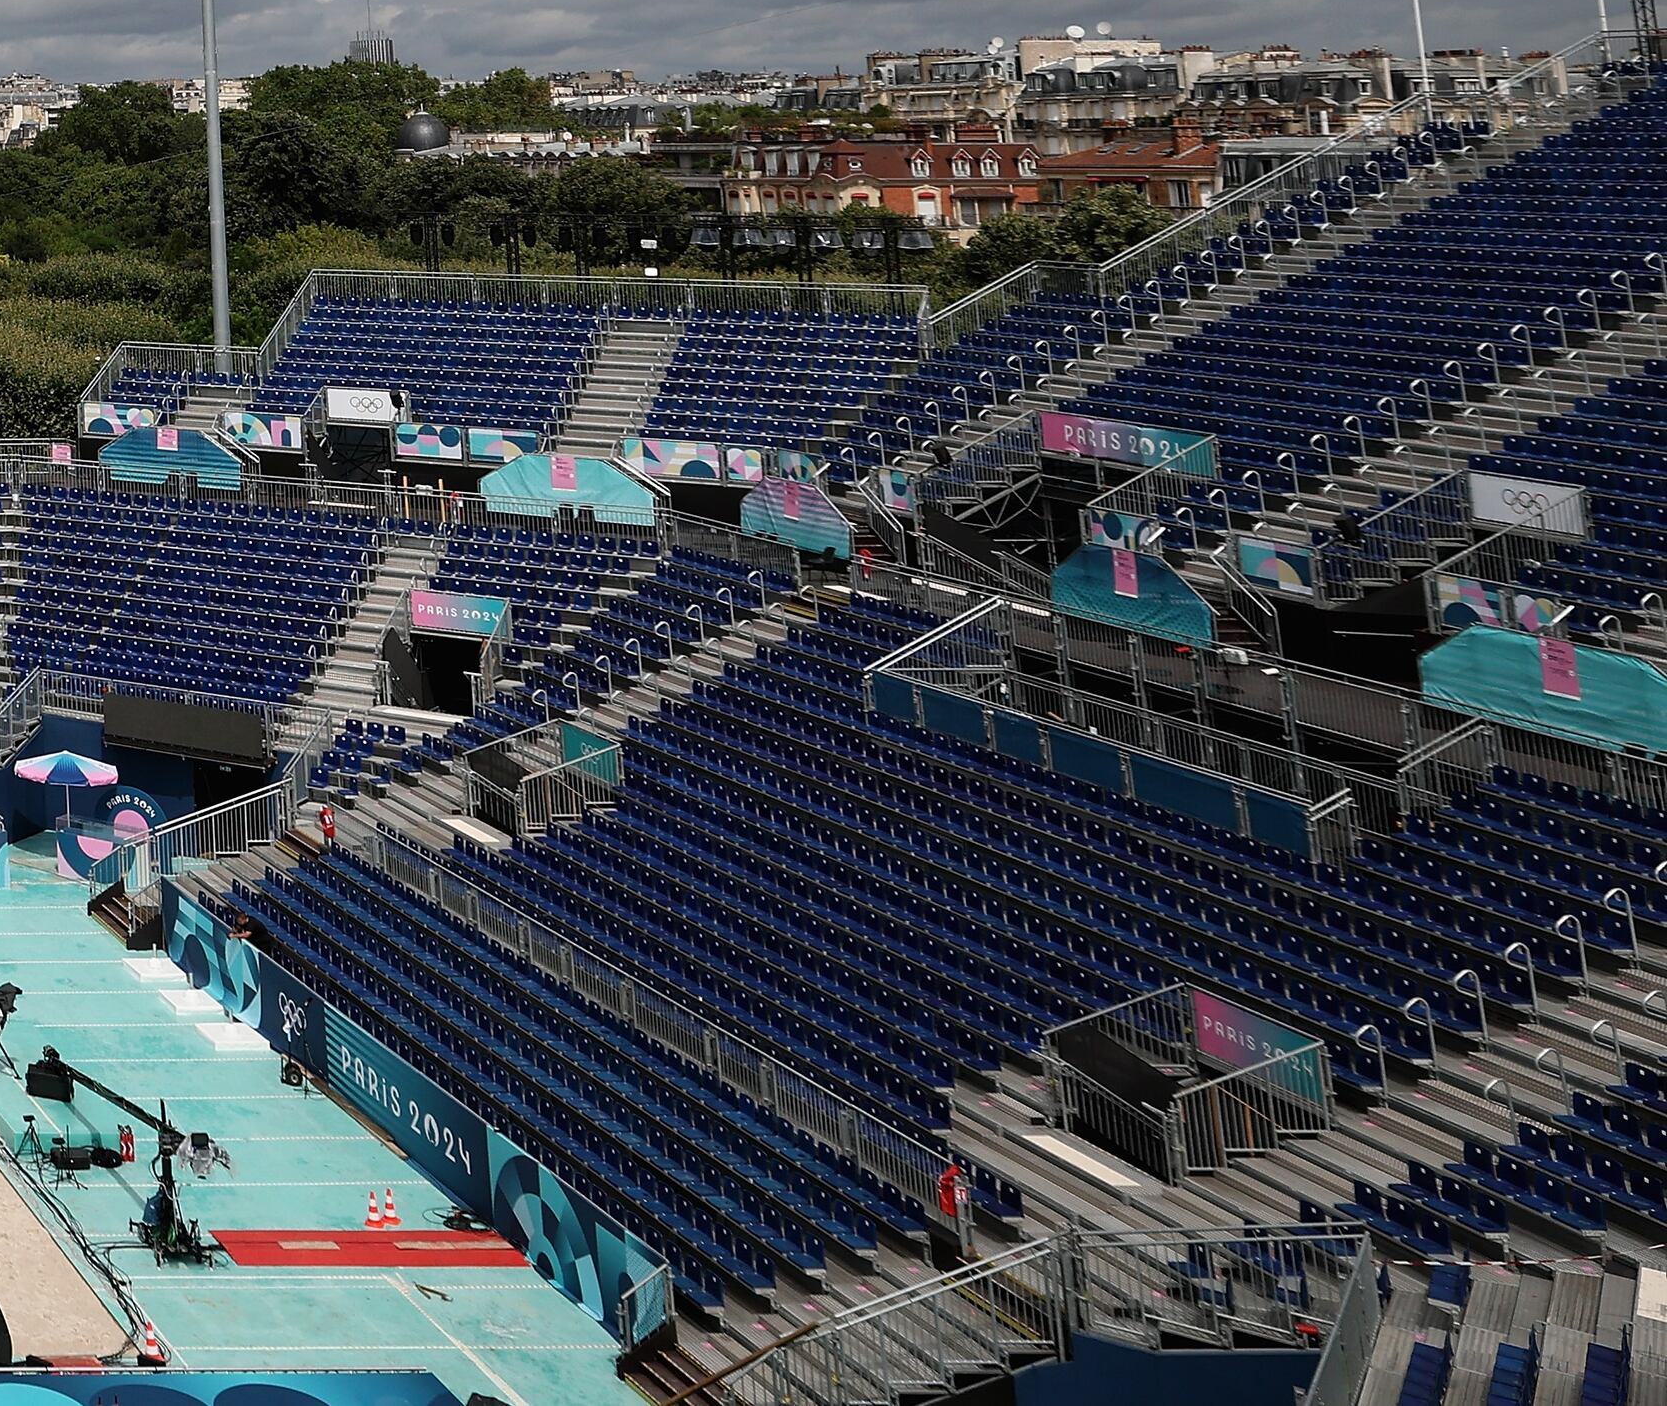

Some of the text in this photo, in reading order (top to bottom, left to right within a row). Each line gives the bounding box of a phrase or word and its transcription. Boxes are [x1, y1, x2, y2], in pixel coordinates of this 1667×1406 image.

[462, 609, 500, 622] 2024
[133, 796, 156, 818] 2024
[409, 1100, 471, 1175] 2024
